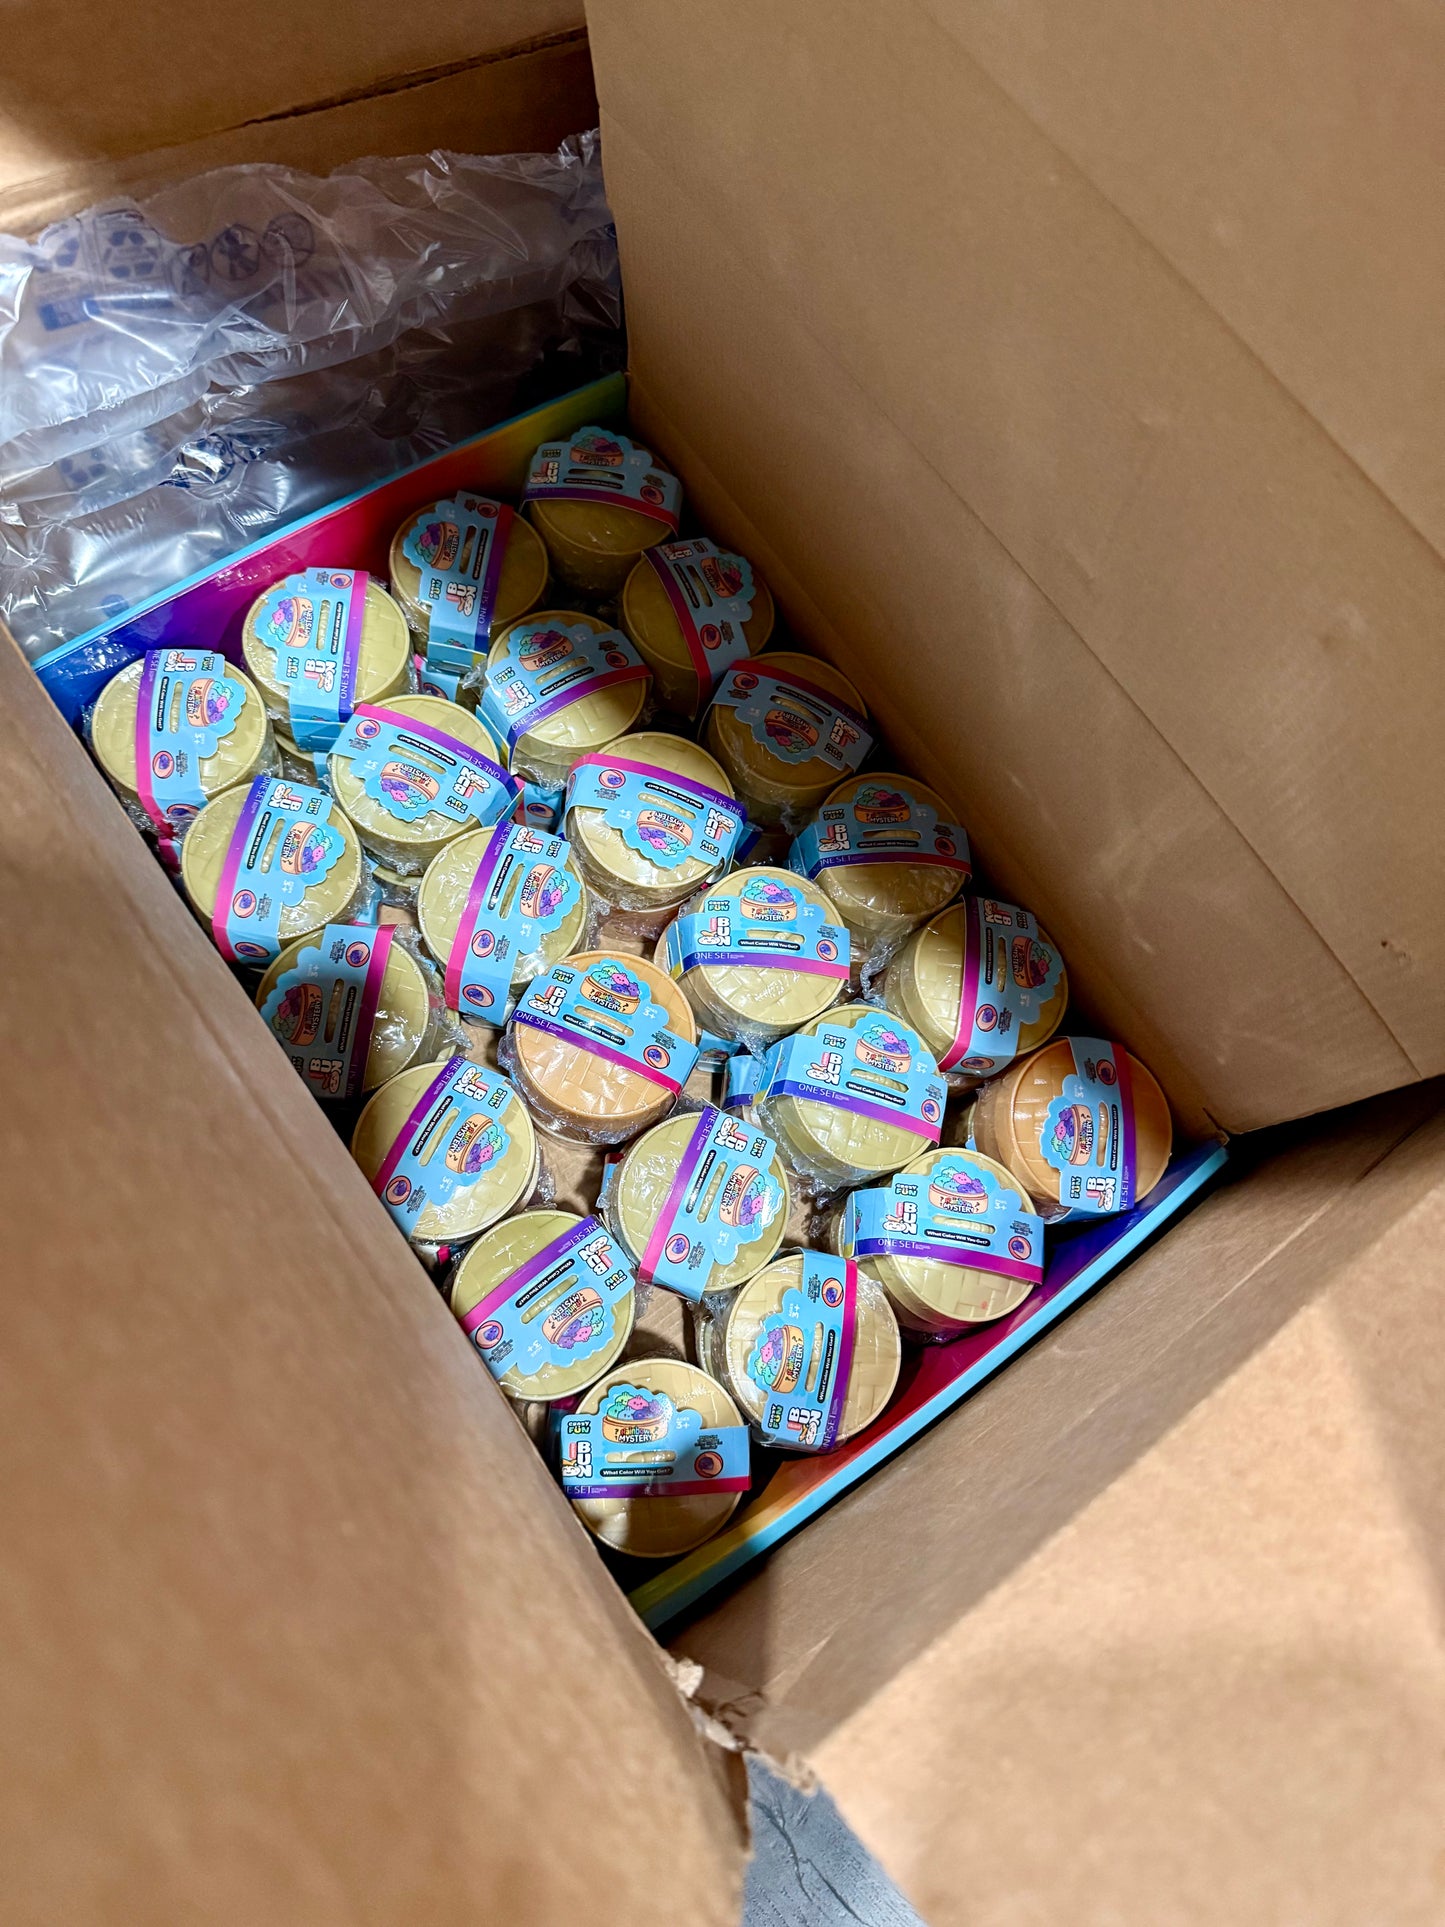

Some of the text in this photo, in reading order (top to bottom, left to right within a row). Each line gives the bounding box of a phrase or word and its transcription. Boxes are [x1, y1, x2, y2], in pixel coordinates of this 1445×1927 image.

[431, 580, 442, 600] FUN
[303, 610, 314, 637] MYSTERY
[478, 607, 487, 624] ONE
[164, 662, 196, 672] BUN
[202, 657, 210, 670] FUN
[288, 658, 298, 678] FUN
[304, 658, 336, 674] BUN
[537, 651, 565, 669] MYSTERY
[342, 664, 350, 678] SET
[495, 670, 515, 684] FUN
[340, 679, 348, 698] ONE
[509, 679, 536, 707] BUN
[185, 689, 197, 714] MYSTERY
[400, 761, 431, 782] MYSTERY
[468, 755, 501, 778] ONE SET
[259, 776, 271, 789] ONE
[451, 766, 476, 796] BUN
[253, 790, 265, 802] SET
[269, 796, 302, 812] BUN
[306, 797, 317, 813] FUN
[447, 796, 468, 811] FUN
[713, 796, 727, 807] SET
[654, 810, 683, 827] MYSTERY
[703, 809, 722, 837] BUN
[279, 831, 296, 859] MYSTERY
[497, 833, 508, 845] SET
[511, 838, 542, 855] BUN
[545, 840, 556, 856] FUN
[702, 839, 721, 852] FUN
[519, 873, 536, 901] MYSTERY
[708, 902, 728, 910] FUN
[754, 913, 784, 922] MYSTERY
[717, 916, 731, 946] BUN
[552, 970, 572, 983] FUN
[543, 985, 569, 1017] BUN
[589, 994, 621, 1013] MYSTERY
[515, 1009, 550, 1028] ONE SET
[824, 1035, 844, 1048] FUN
[440, 1056, 464, 1084] ONE SET
[825, 1052, 844, 1085] BUN
[866, 1058, 896, 1074] MYSTERY
[453, 1078, 487, 1102] BUN
[487, 1087, 504, 1106] FUN
[798, 1082, 818, 1094] ONE
[819, 1088, 835, 1099] SET
[446, 1121, 471, 1153] MYSTERY
[700, 1124, 712, 1138] SET
[1084, 1120, 1093, 1152] MYSTERY
[714, 1131, 747, 1153] BUN
[750, 1137, 764, 1156] FUN
[719, 1174, 738, 1206] MYSTERY
[895, 1185, 916, 1196] FUN
[1073, 1178, 1081, 1198] FUN
[1087, 1176, 1115, 1192] BUN
[902, 1201, 918, 1235] BUN
[942, 1203, 974, 1215] MYSTERY
[569, 1231, 585, 1245] SET
[877, 1237, 897, 1247] ONE
[899, 1240, 914, 1249] SET
[578, 1244, 609, 1277] BUN
[605, 1269, 625, 1287] FUN
[549, 1291, 581, 1319] MYSTERY
[791, 1344, 805, 1380] MYSTERY
[772, 1406, 783, 1429] FUN
[788, 1406, 822, 1426] BUN
[826, 1414, 836, 1431] SET
[568, 1425, 589, 1433] FUN
[618, 1434, 652, 1443] MYSTERY
[577, 1441, 592, 1477] BUN
